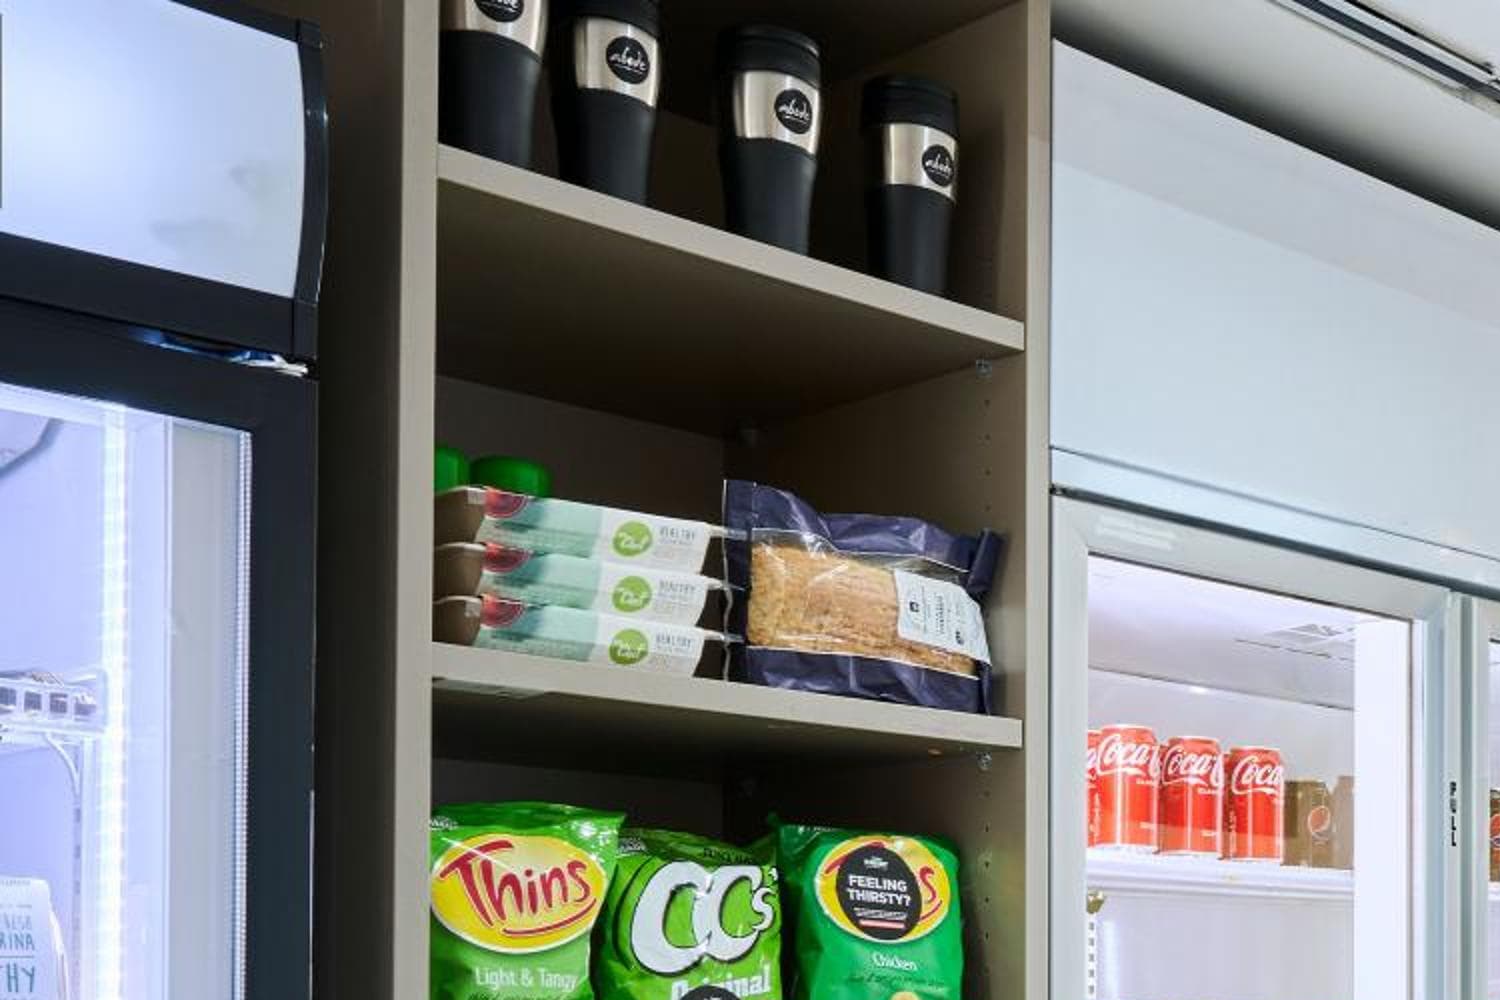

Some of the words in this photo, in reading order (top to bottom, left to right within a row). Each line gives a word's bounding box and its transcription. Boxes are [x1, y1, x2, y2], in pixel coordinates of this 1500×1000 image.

[440, 840, 591, 927] Thins
[848, 875, 907, 893] FEELING
[847, 887, 911, 907] THIRSTY?
[873, 952, 918, 971] Chicken
[475, 966, 515, 990] Light
[520, 970, 534, 987] &
[540, 968, 578, 992] Tangy
